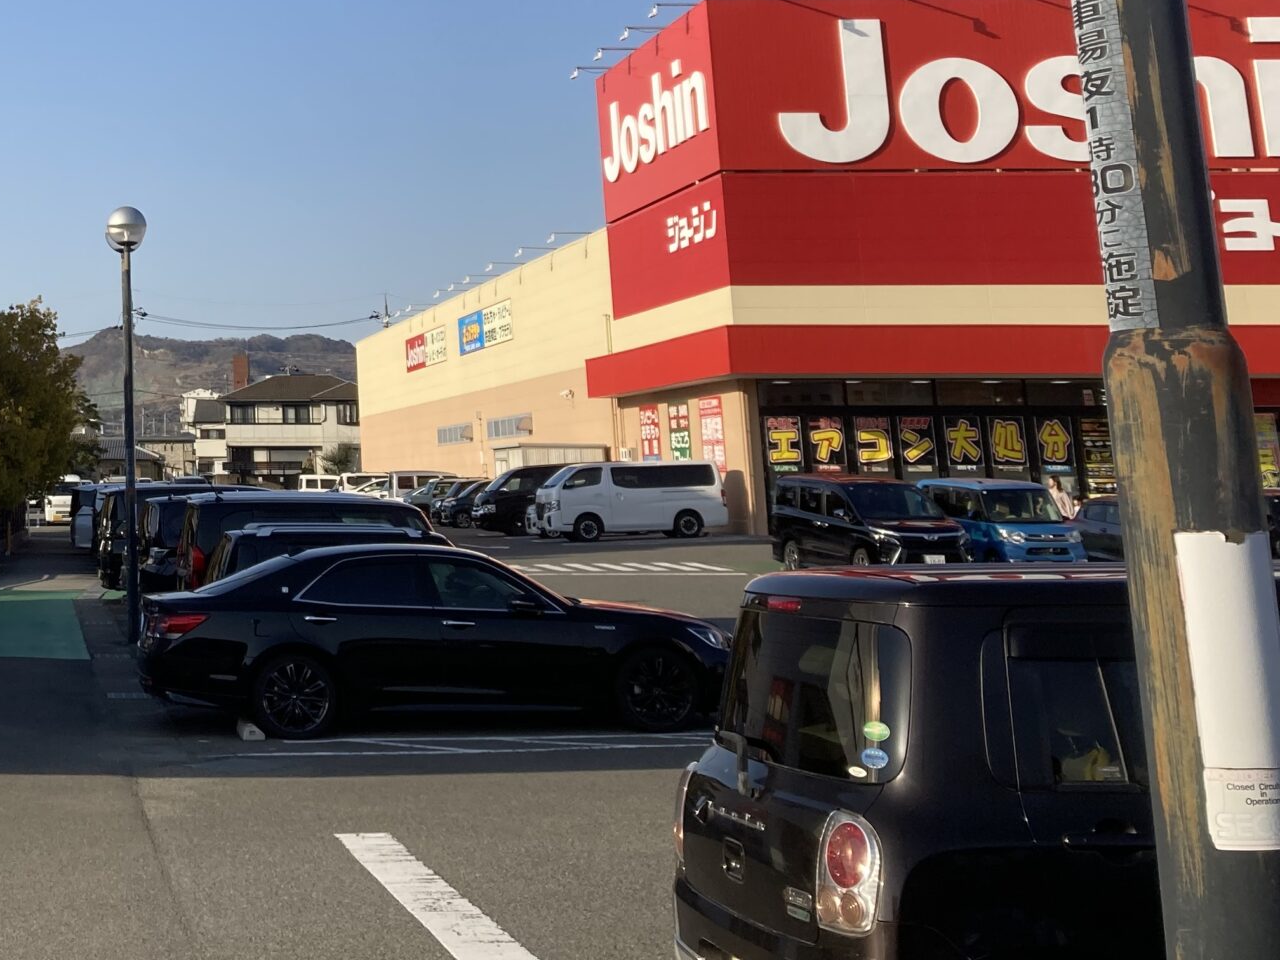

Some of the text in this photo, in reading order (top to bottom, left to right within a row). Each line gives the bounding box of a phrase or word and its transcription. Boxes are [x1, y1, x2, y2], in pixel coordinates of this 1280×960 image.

[603, 59, 710, 183] Joshin
[667, 201, 717, 253] ジョーシン
[407, 339, 425, 369] Joshin
[1226, 783, 1256, 791] Closed
